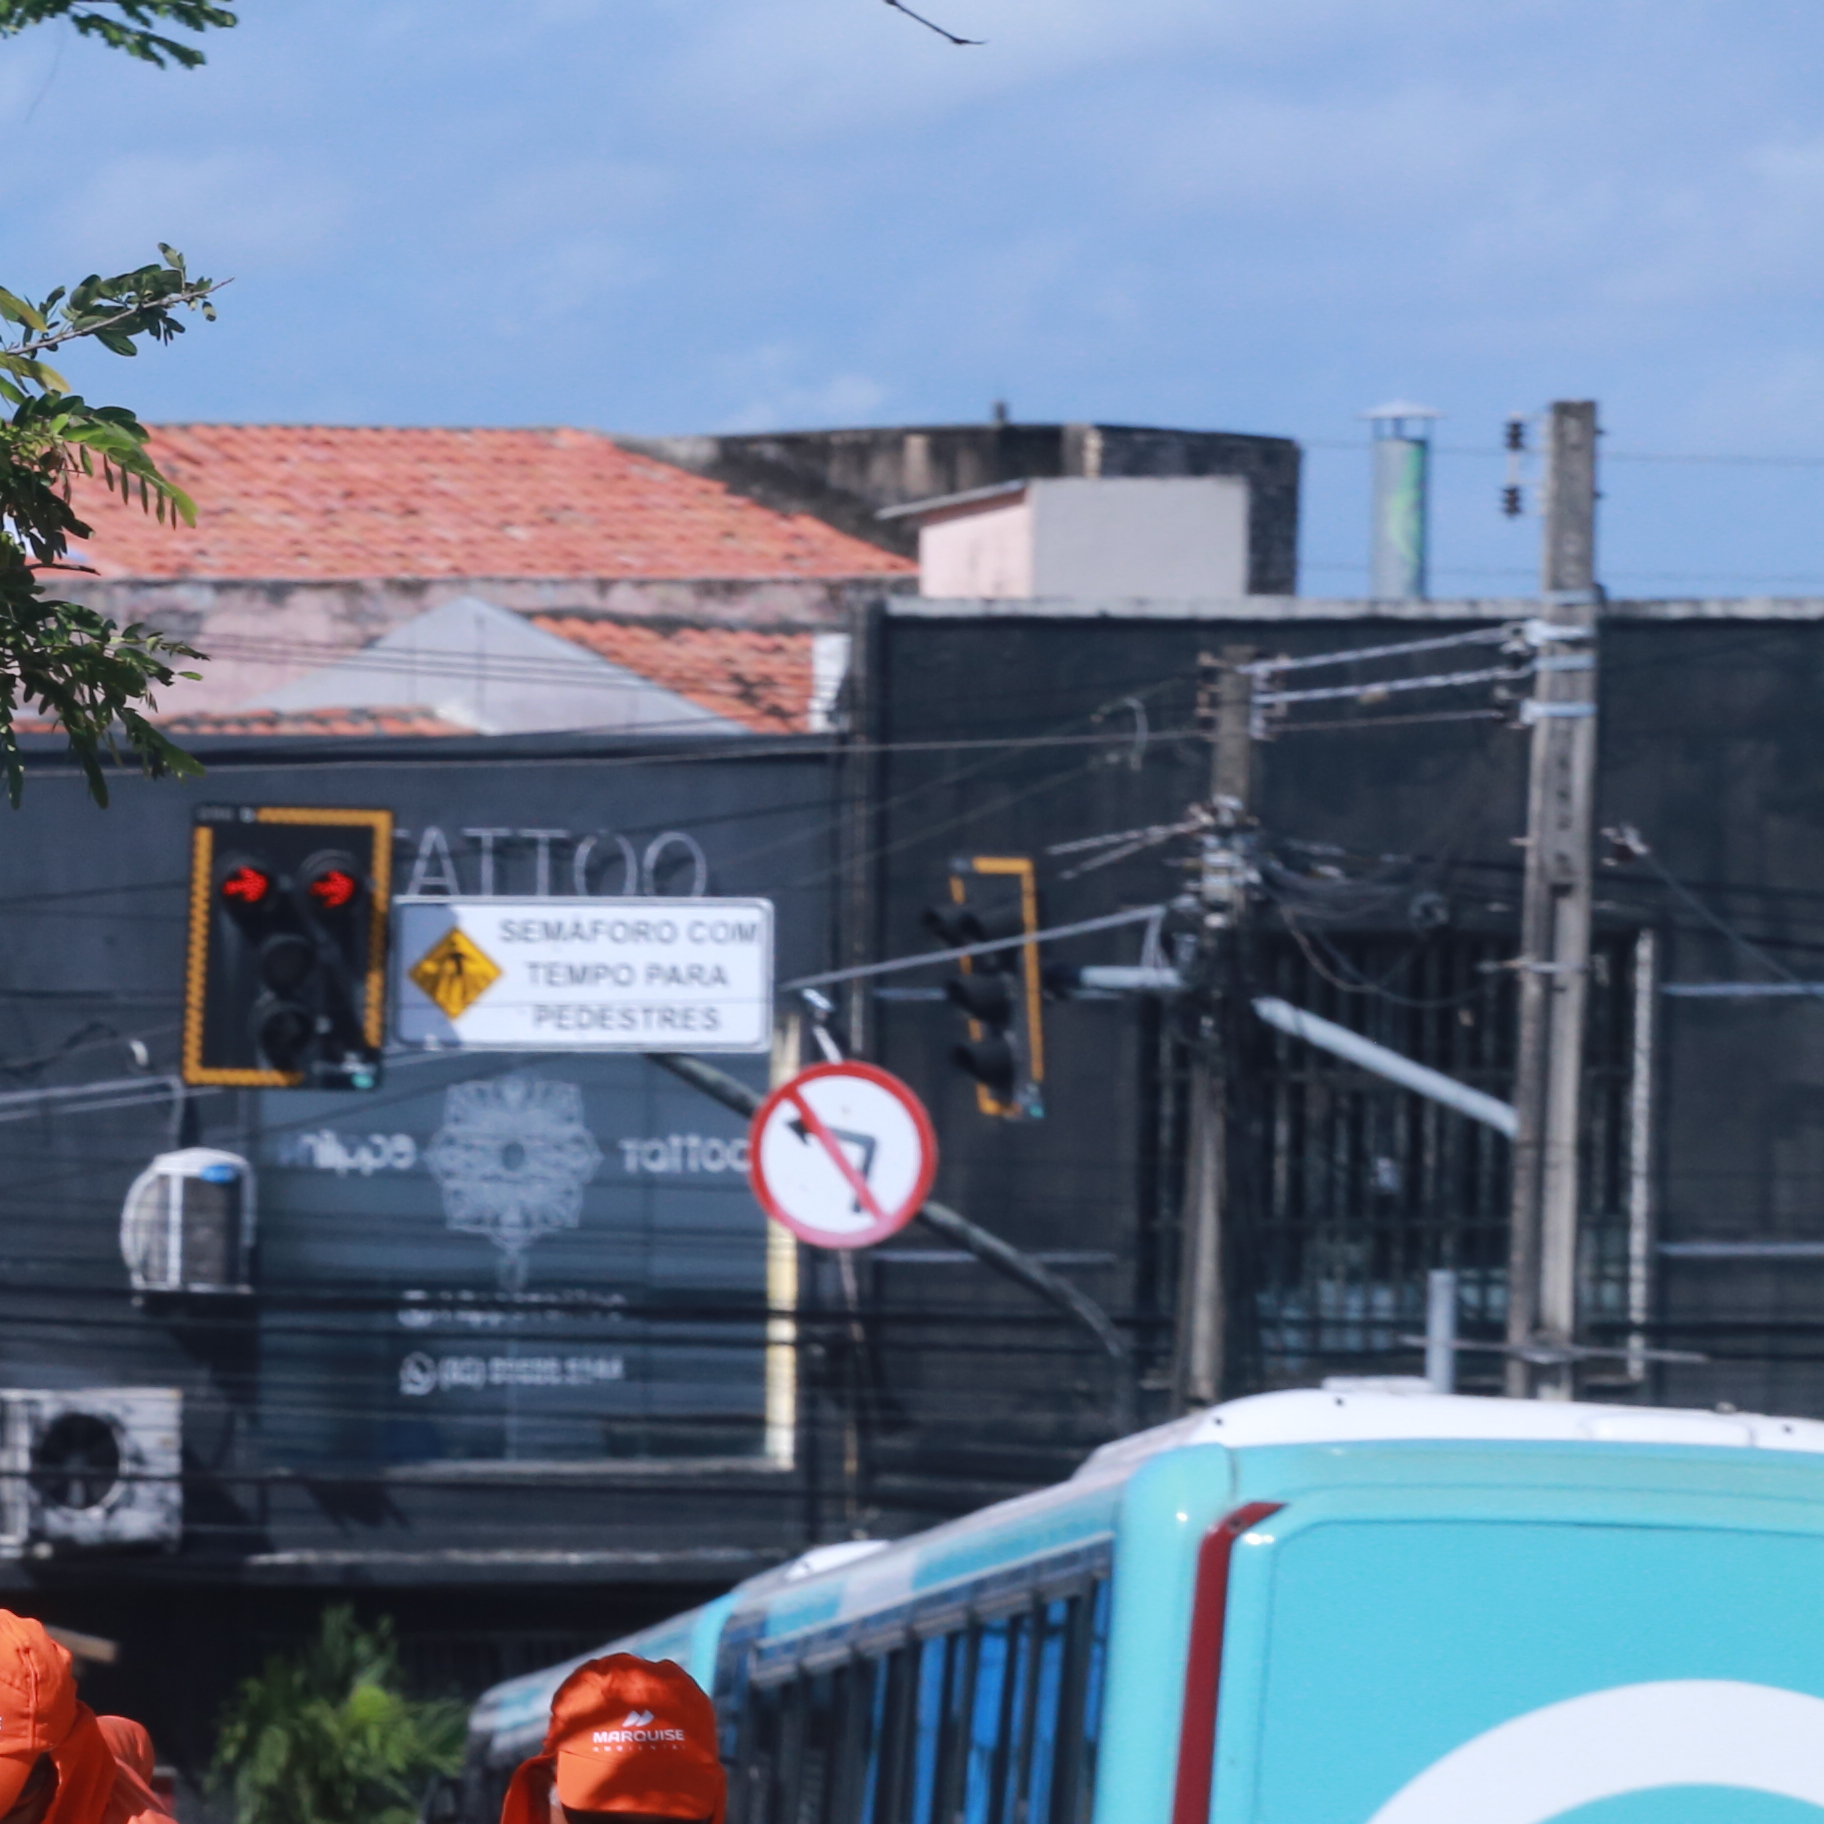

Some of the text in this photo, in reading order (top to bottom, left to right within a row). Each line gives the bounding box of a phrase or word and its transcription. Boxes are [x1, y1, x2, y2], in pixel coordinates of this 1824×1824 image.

[686, 920, 759, 946] COM
[526, 960, 730, 988] TEMPO PARA
[532, 1004, 723, 1032] PEDESTRES
[592, 1730, 686, 1743] MARQUISE
